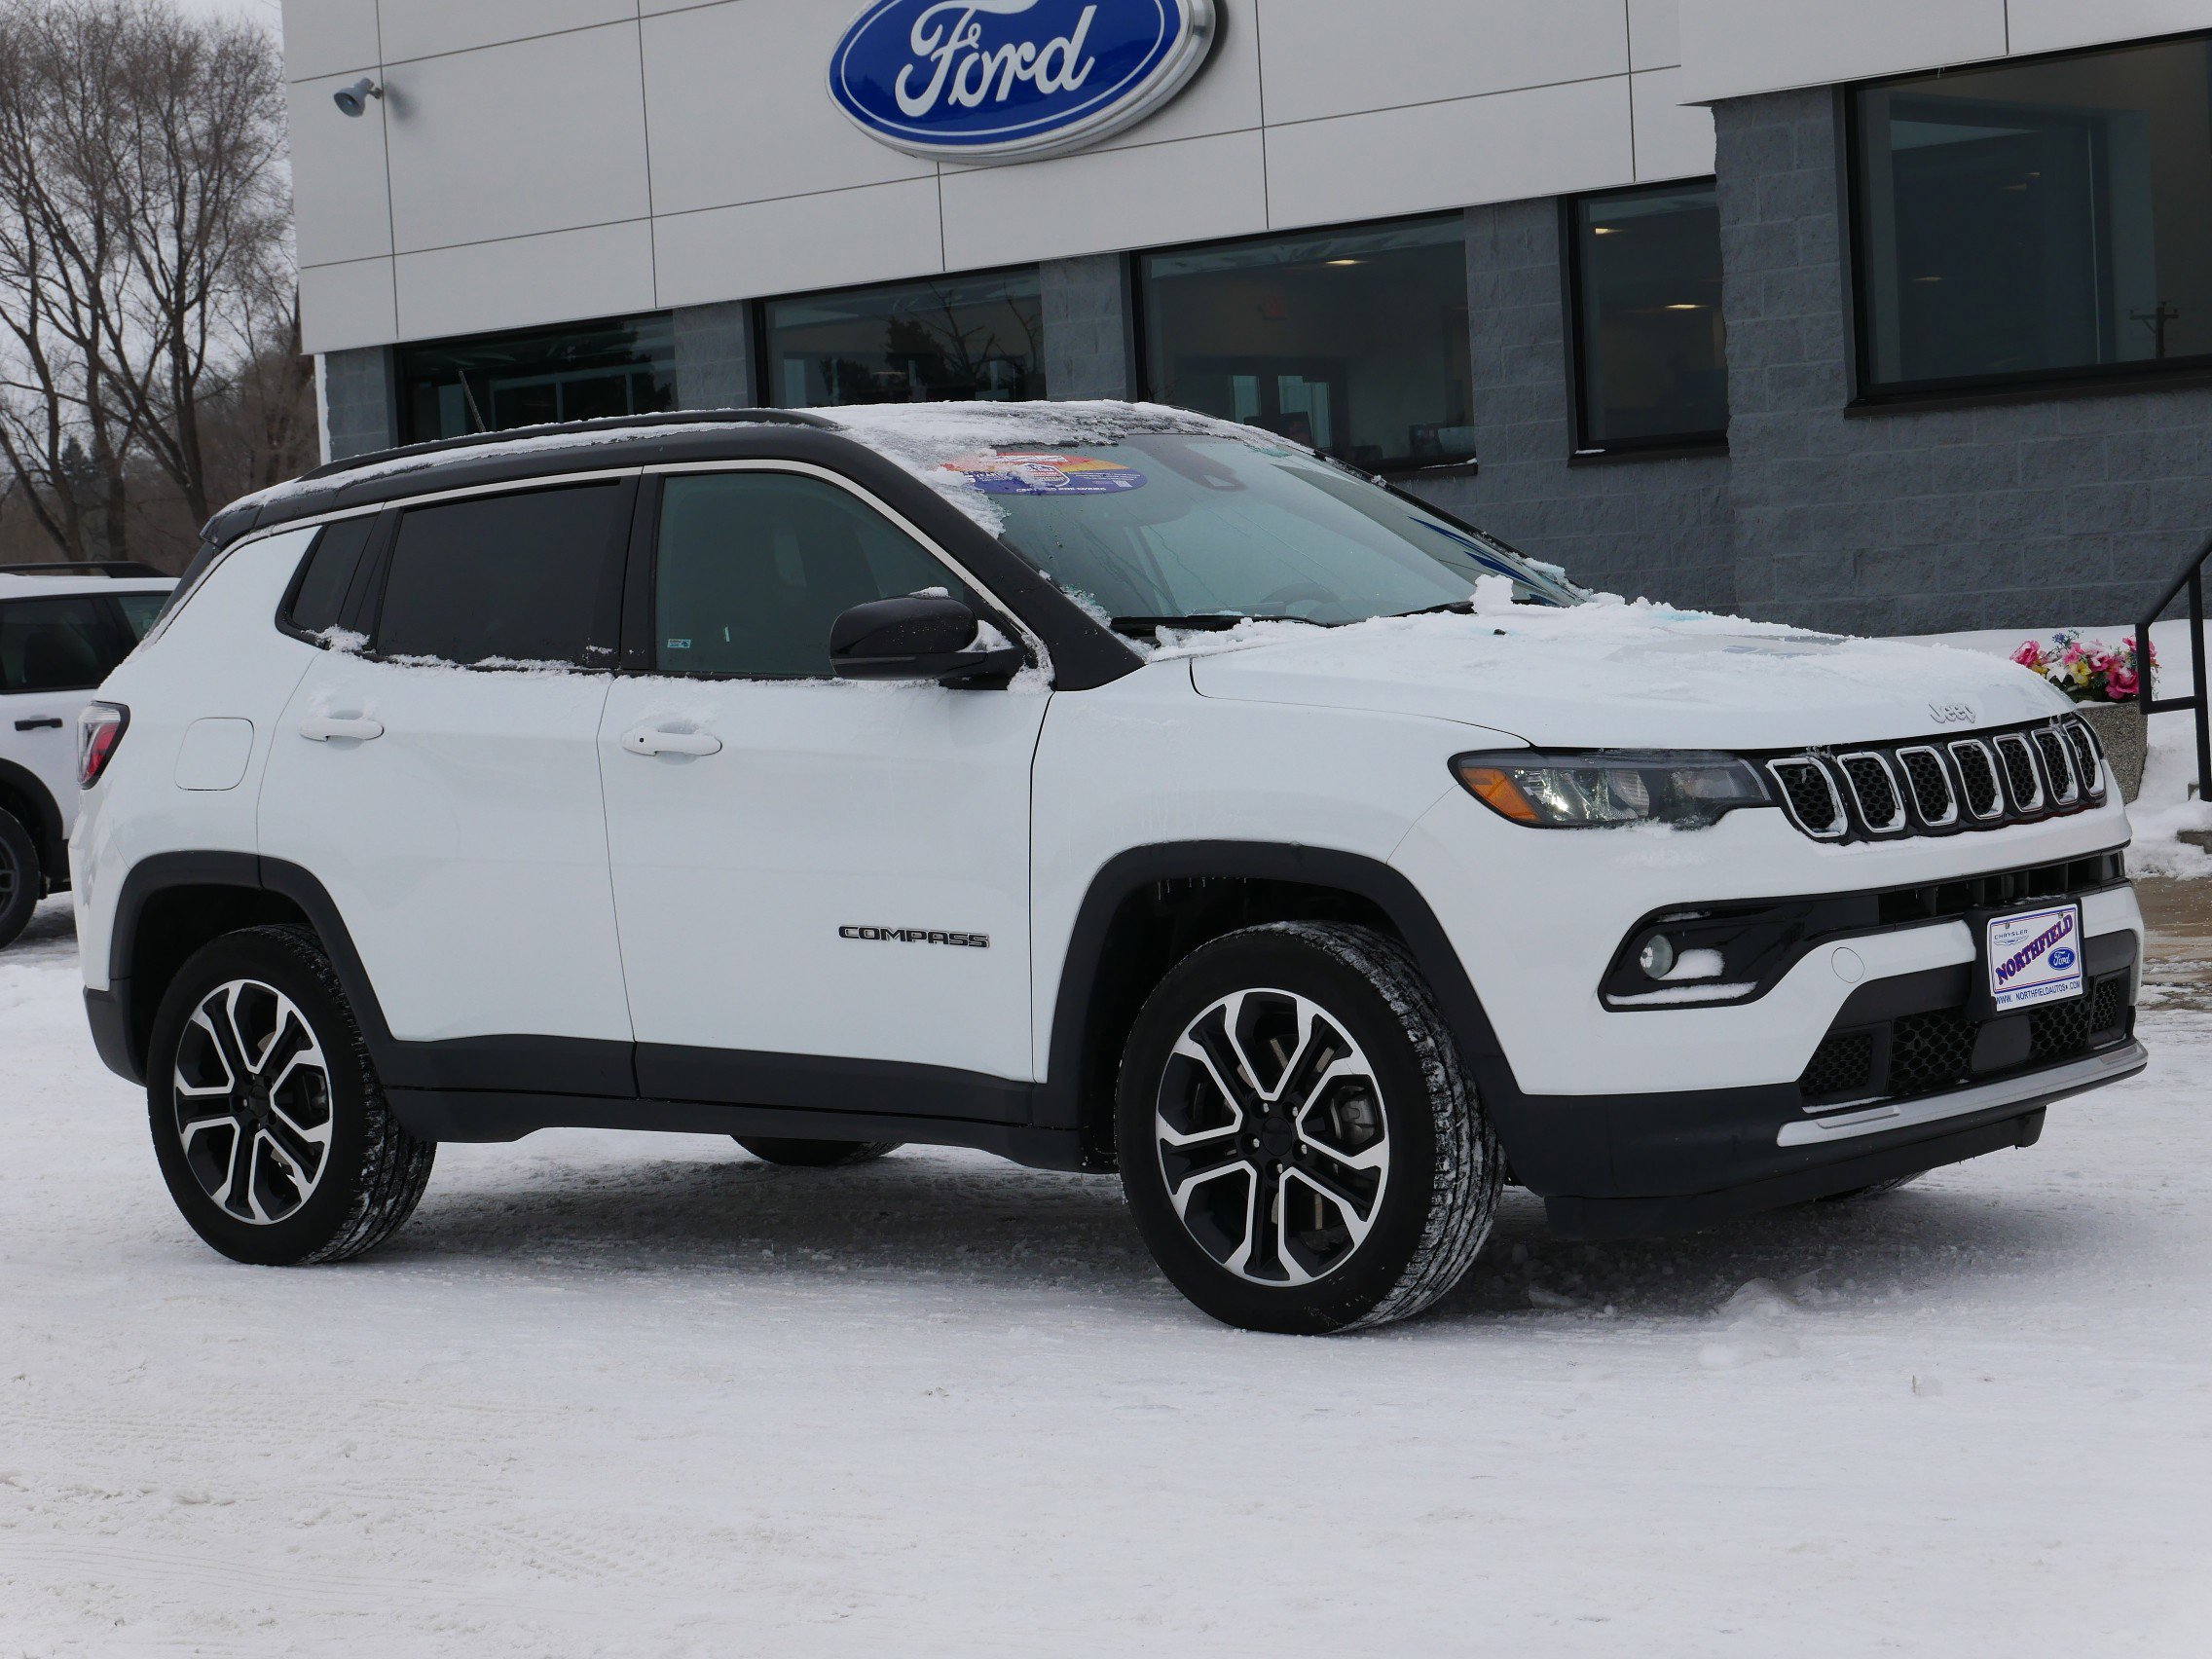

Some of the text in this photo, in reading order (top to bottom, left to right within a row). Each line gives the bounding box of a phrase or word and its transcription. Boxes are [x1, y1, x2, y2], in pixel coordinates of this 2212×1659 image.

[895, 0, 1097, 117] Ford
[1928, 703, 1976, 723] Jeep
[838, 926, 990, 948] COMPASS
[1994, 929, 2028, 940] CHRYSLER
[1995, 913, 2074, 985] NORTHFIELD
